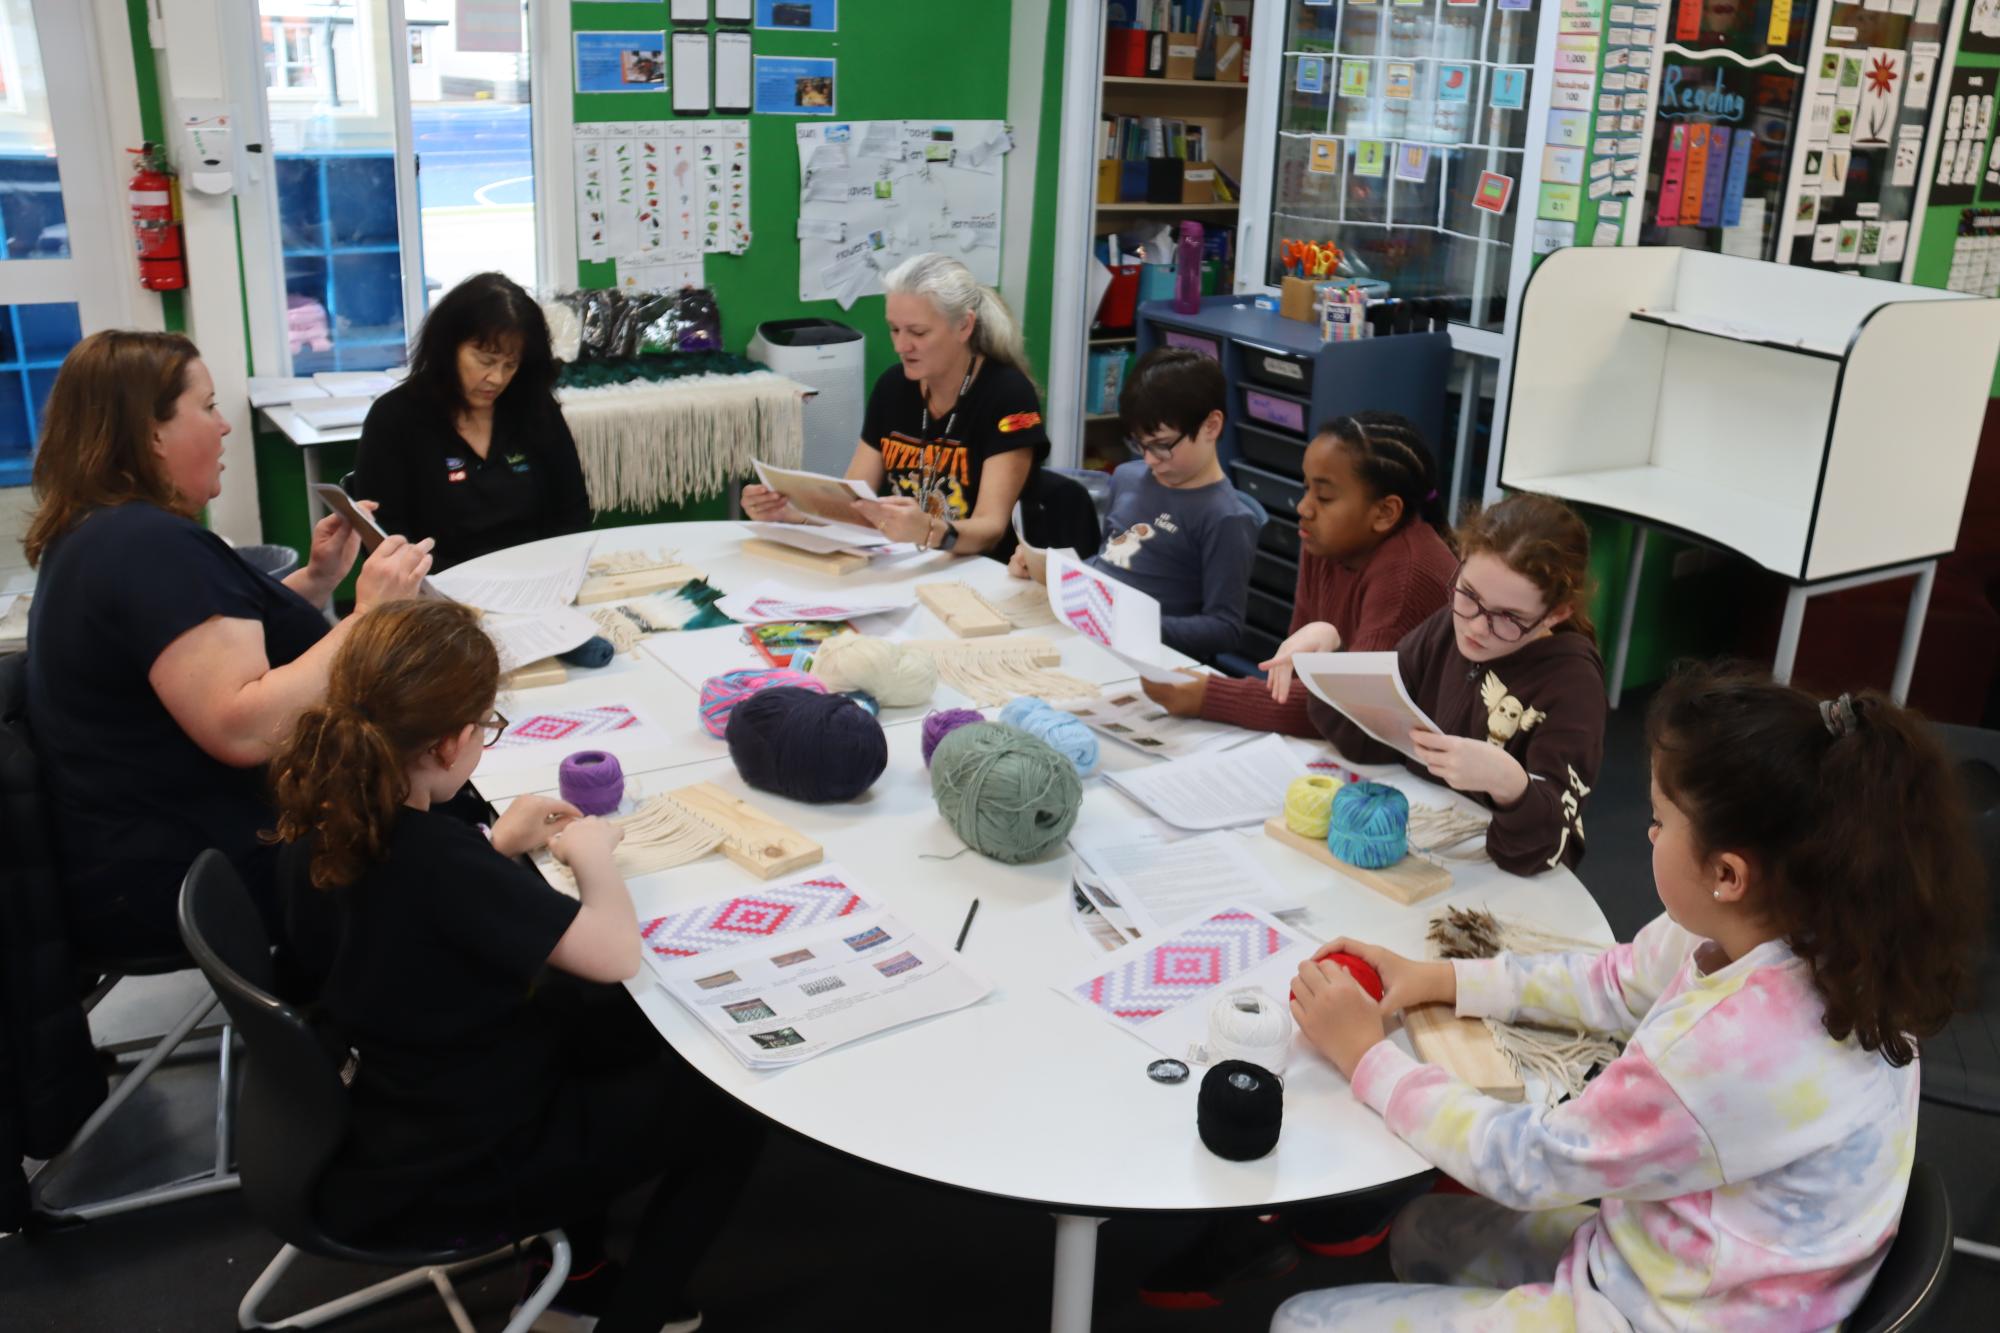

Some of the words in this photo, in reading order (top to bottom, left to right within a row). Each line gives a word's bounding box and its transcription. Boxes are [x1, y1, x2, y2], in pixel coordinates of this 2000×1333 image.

[1566, 54, 1587, 63] 1,000
[1556, 81, 1590, 91] hundreds
[1662, 64, 1745, 115] Reading
[1566, 92, 1580, 102] 100
[1563, 128, 1573, 137] 10
